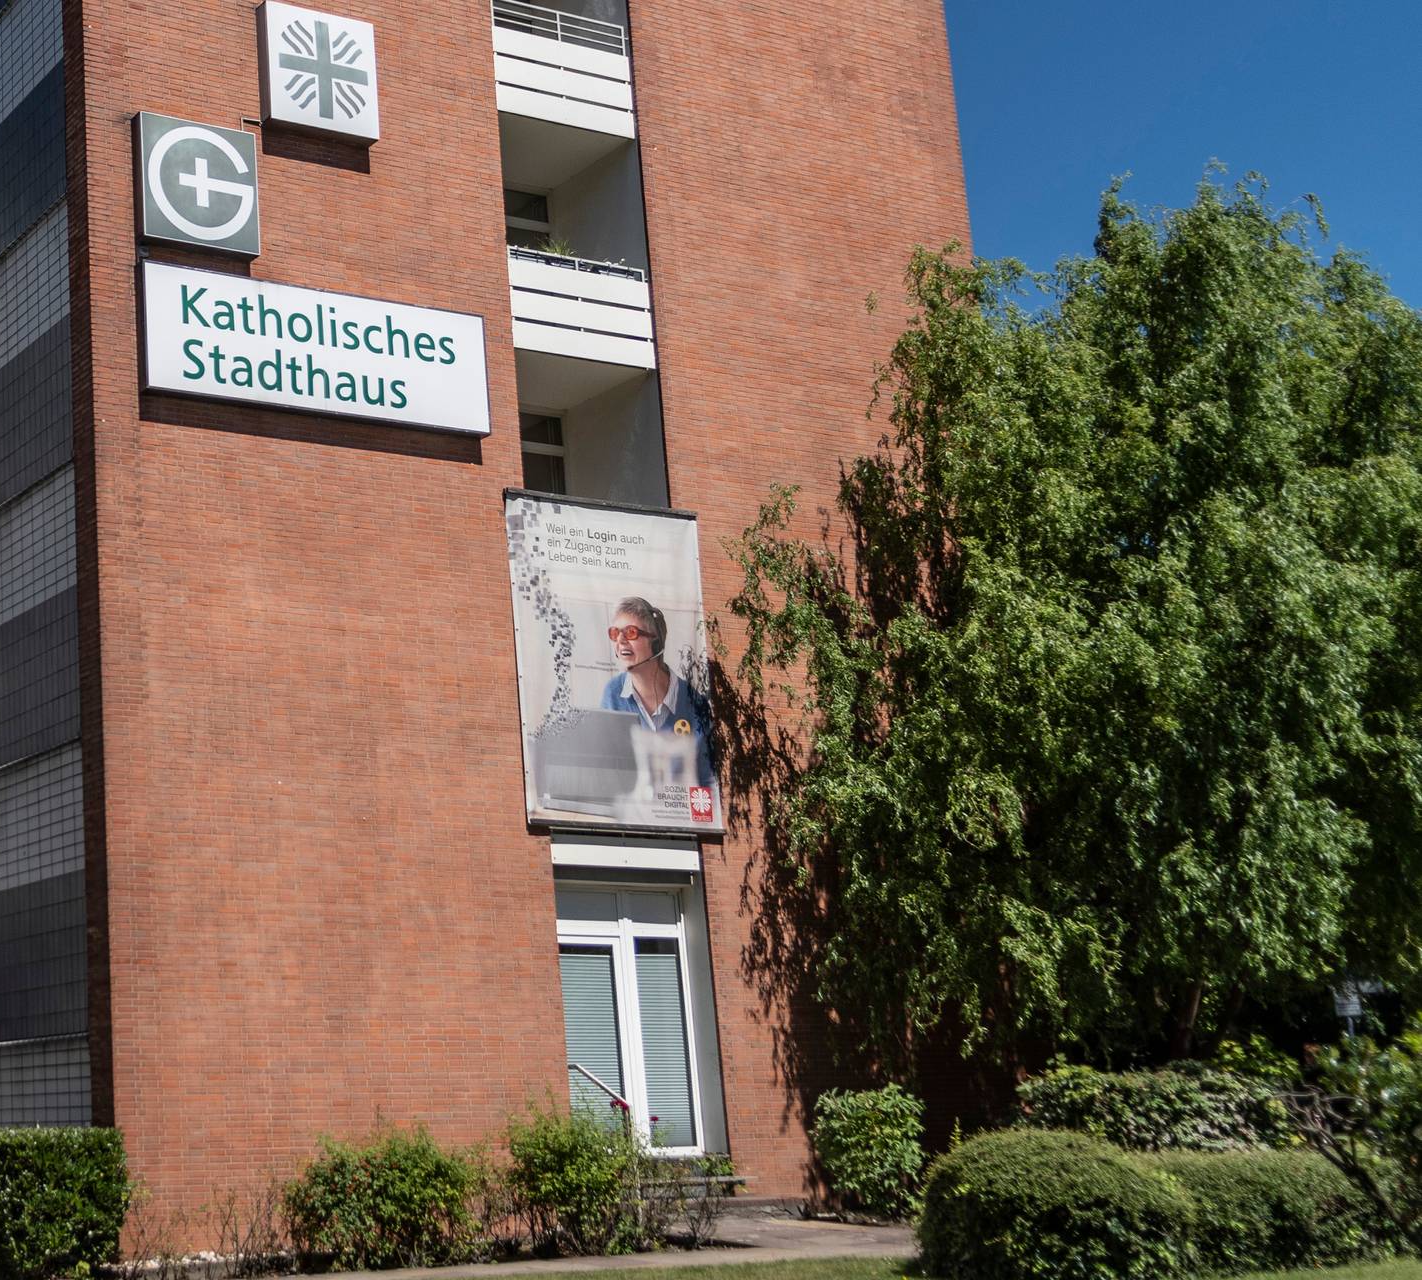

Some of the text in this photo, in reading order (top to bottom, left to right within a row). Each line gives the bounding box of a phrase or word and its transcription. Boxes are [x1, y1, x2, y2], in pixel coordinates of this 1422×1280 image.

[180, 284, 456, 365] Katholisches
[183, 338, 408, 409] Stadthaus
[546, 523, 645, 544] Weil ein Login auch
[547, 537, 626, 556] ein Zugang zum
[548, 550, 632, 570] Leben sein kann.
[658, 793, 689, 801] BRAUCHT
[665, 786, 689, 794] SOZIAL
[665, 801, 689, 809] DIGITAL
